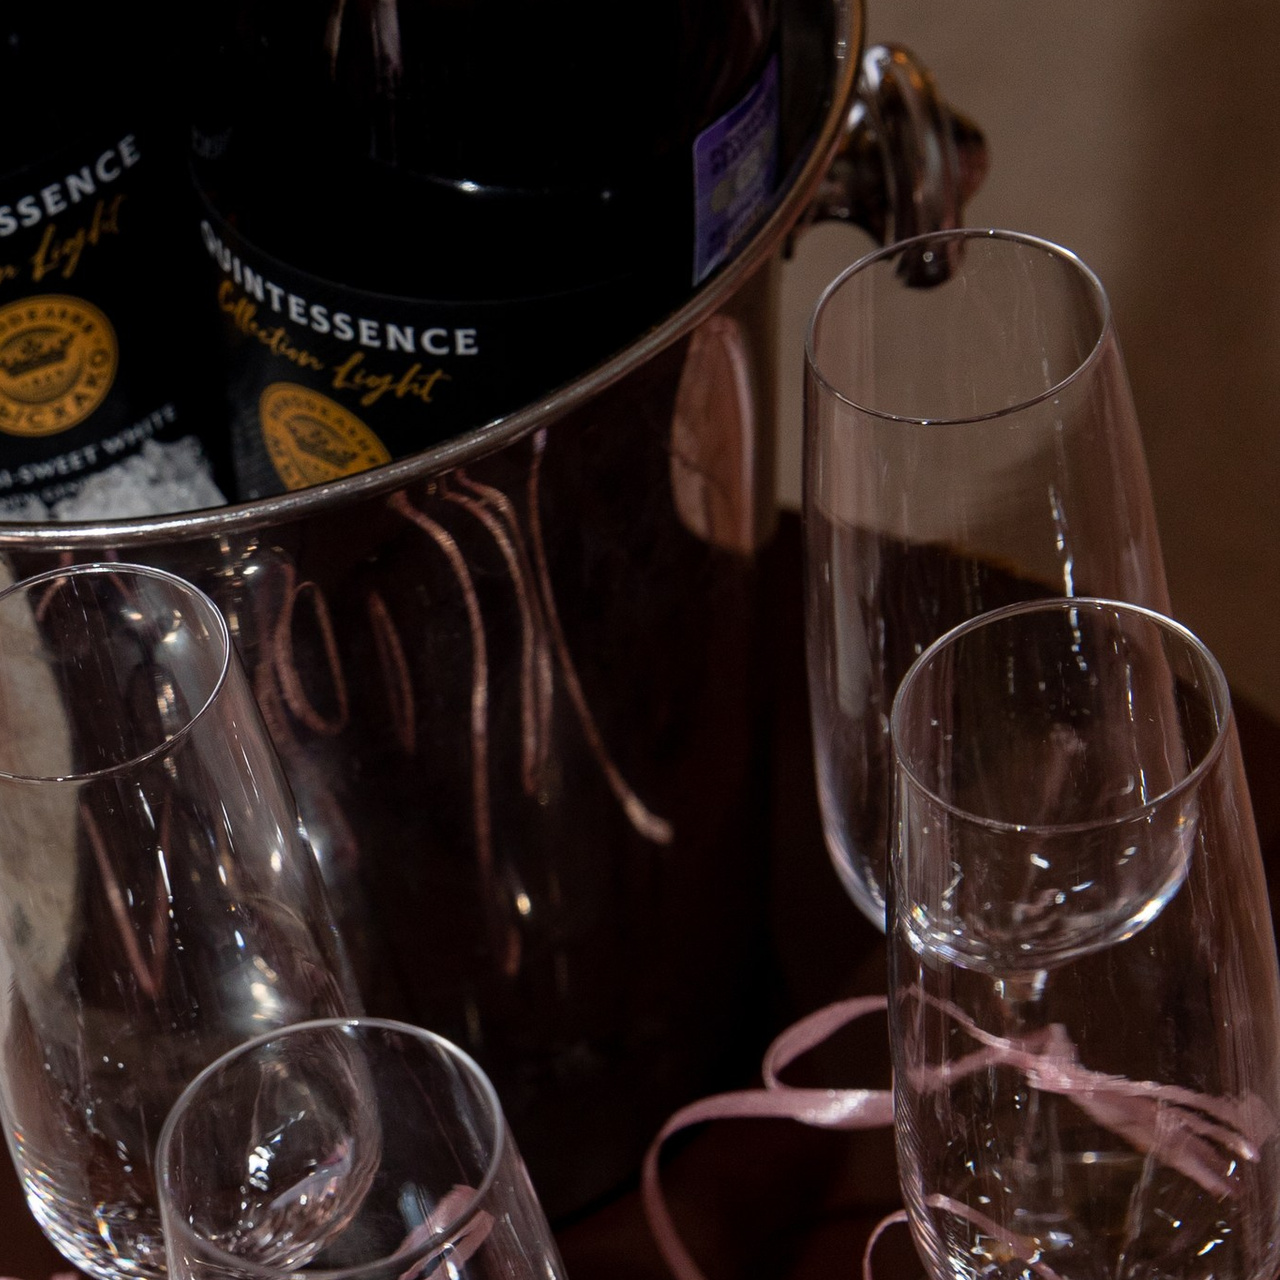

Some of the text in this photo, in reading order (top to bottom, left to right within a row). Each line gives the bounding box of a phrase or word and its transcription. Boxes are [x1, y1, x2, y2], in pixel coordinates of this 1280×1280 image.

[30, 196, 123, 280] Light
[217, 280, 452, 406] Collection Light
